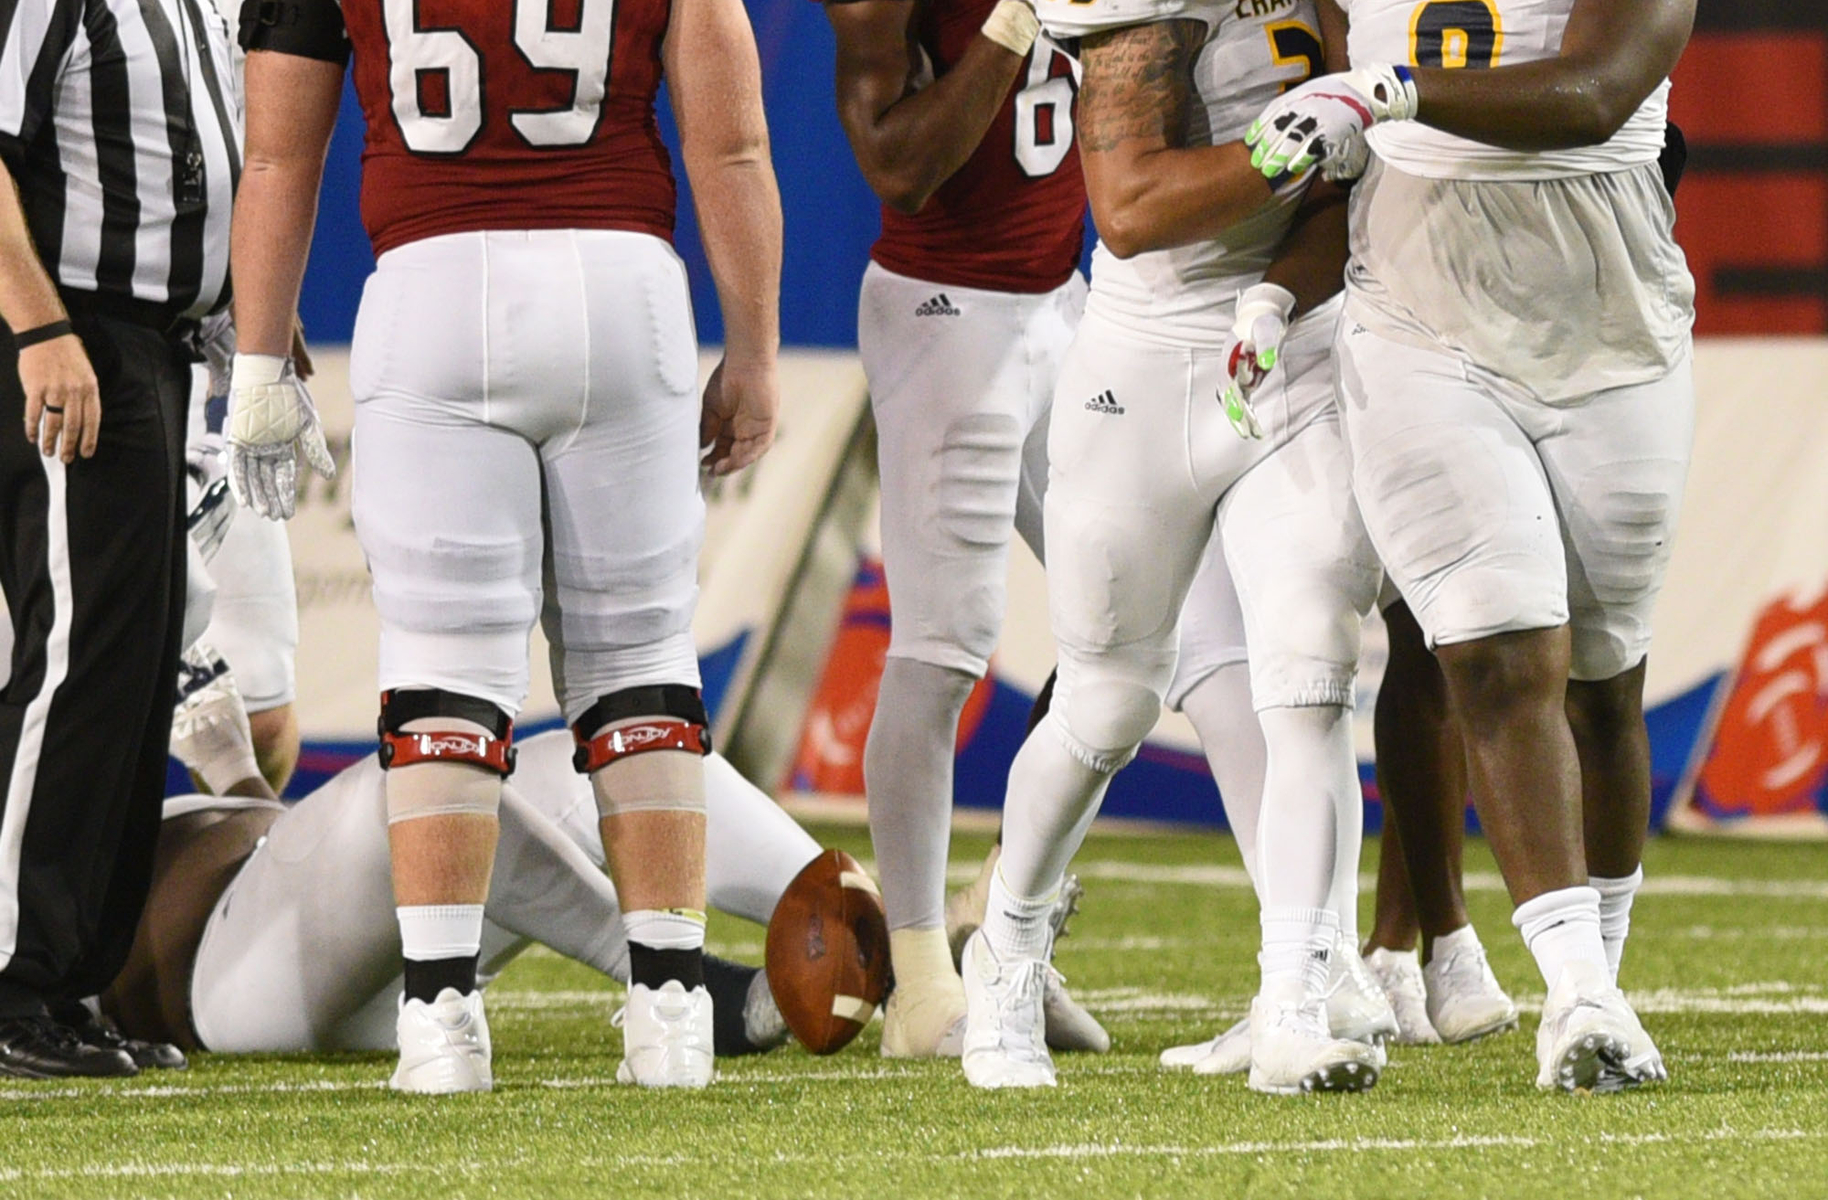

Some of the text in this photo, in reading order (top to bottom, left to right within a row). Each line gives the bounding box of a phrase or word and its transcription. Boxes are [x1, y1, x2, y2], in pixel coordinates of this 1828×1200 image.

[1012, 25, 1080, 180] 6
[915, 306, 961, 317] adidas
[1084, 401, 1125, 415] adidas
